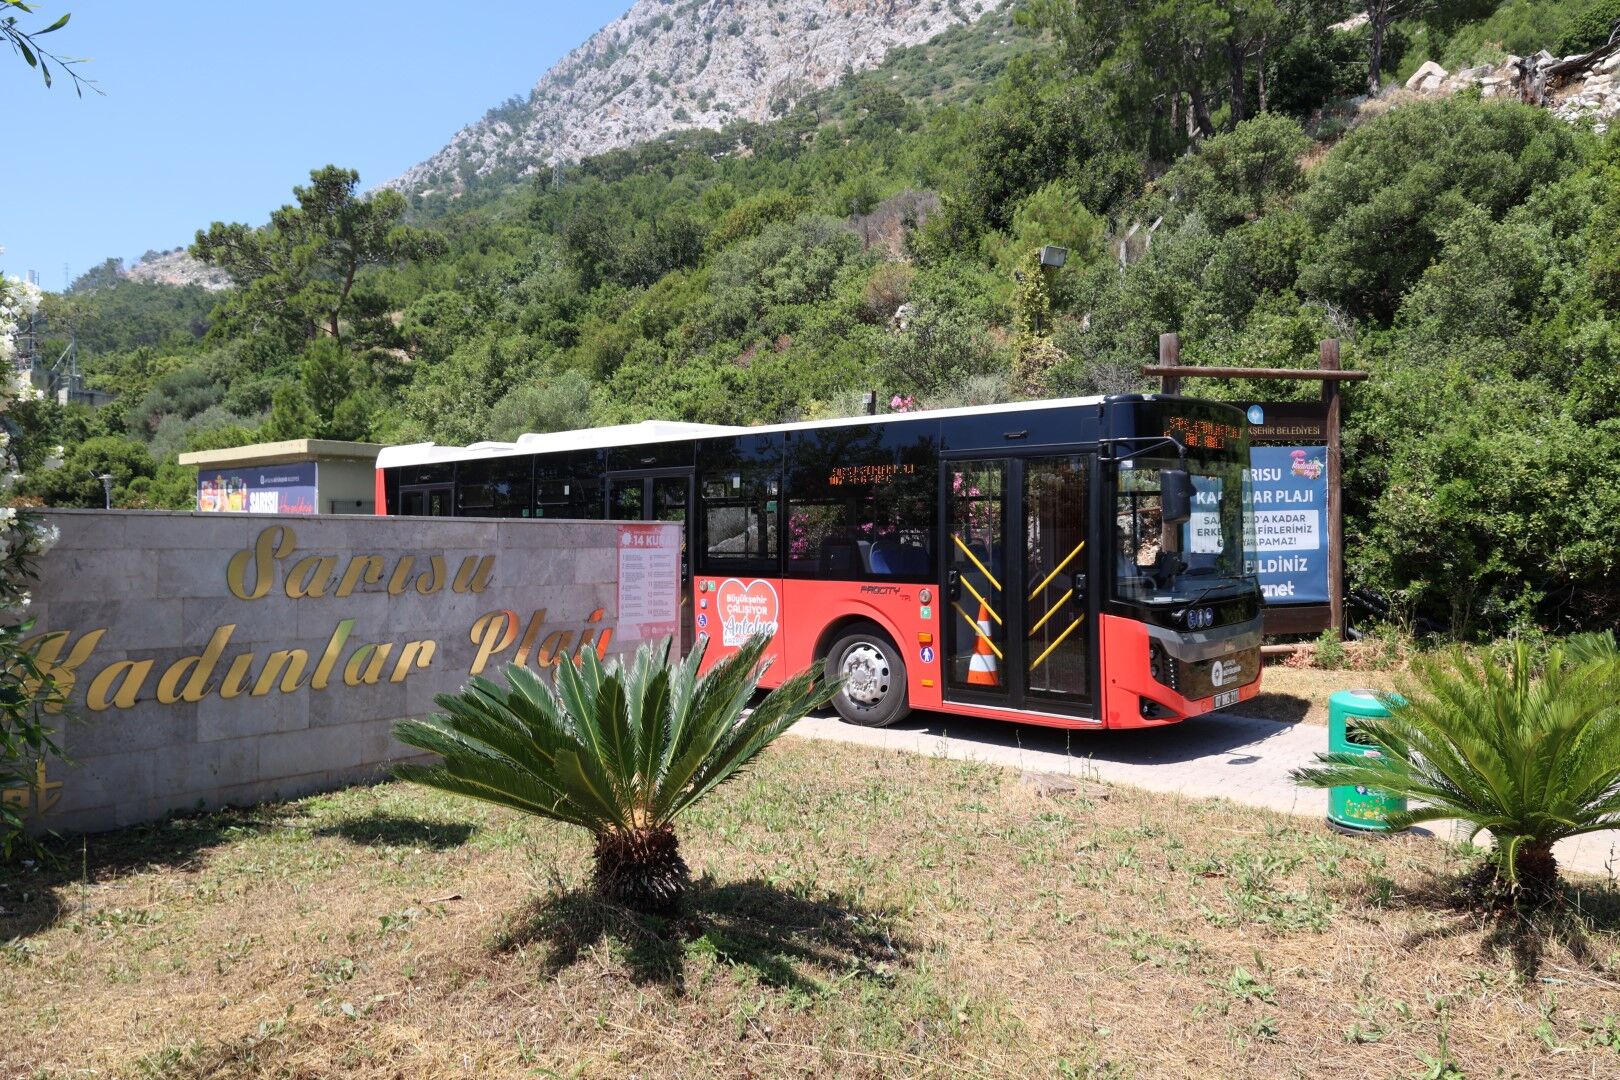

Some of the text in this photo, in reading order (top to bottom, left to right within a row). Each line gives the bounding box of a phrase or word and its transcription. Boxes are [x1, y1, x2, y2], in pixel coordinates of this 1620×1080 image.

[1277, 425, 1321, 435] BELEDİYESİ
[1275, 490, 1313, 503] PLAJI
[1272, 514, 1306, 523] KADAR
[227, 524, 497, 601] Sarısu
[726, 593, 768, 604] Büyükşehir
[726, 604, 768, 616] ÇALIŞIYOR
[724, 615, 776, 637] Antalya
